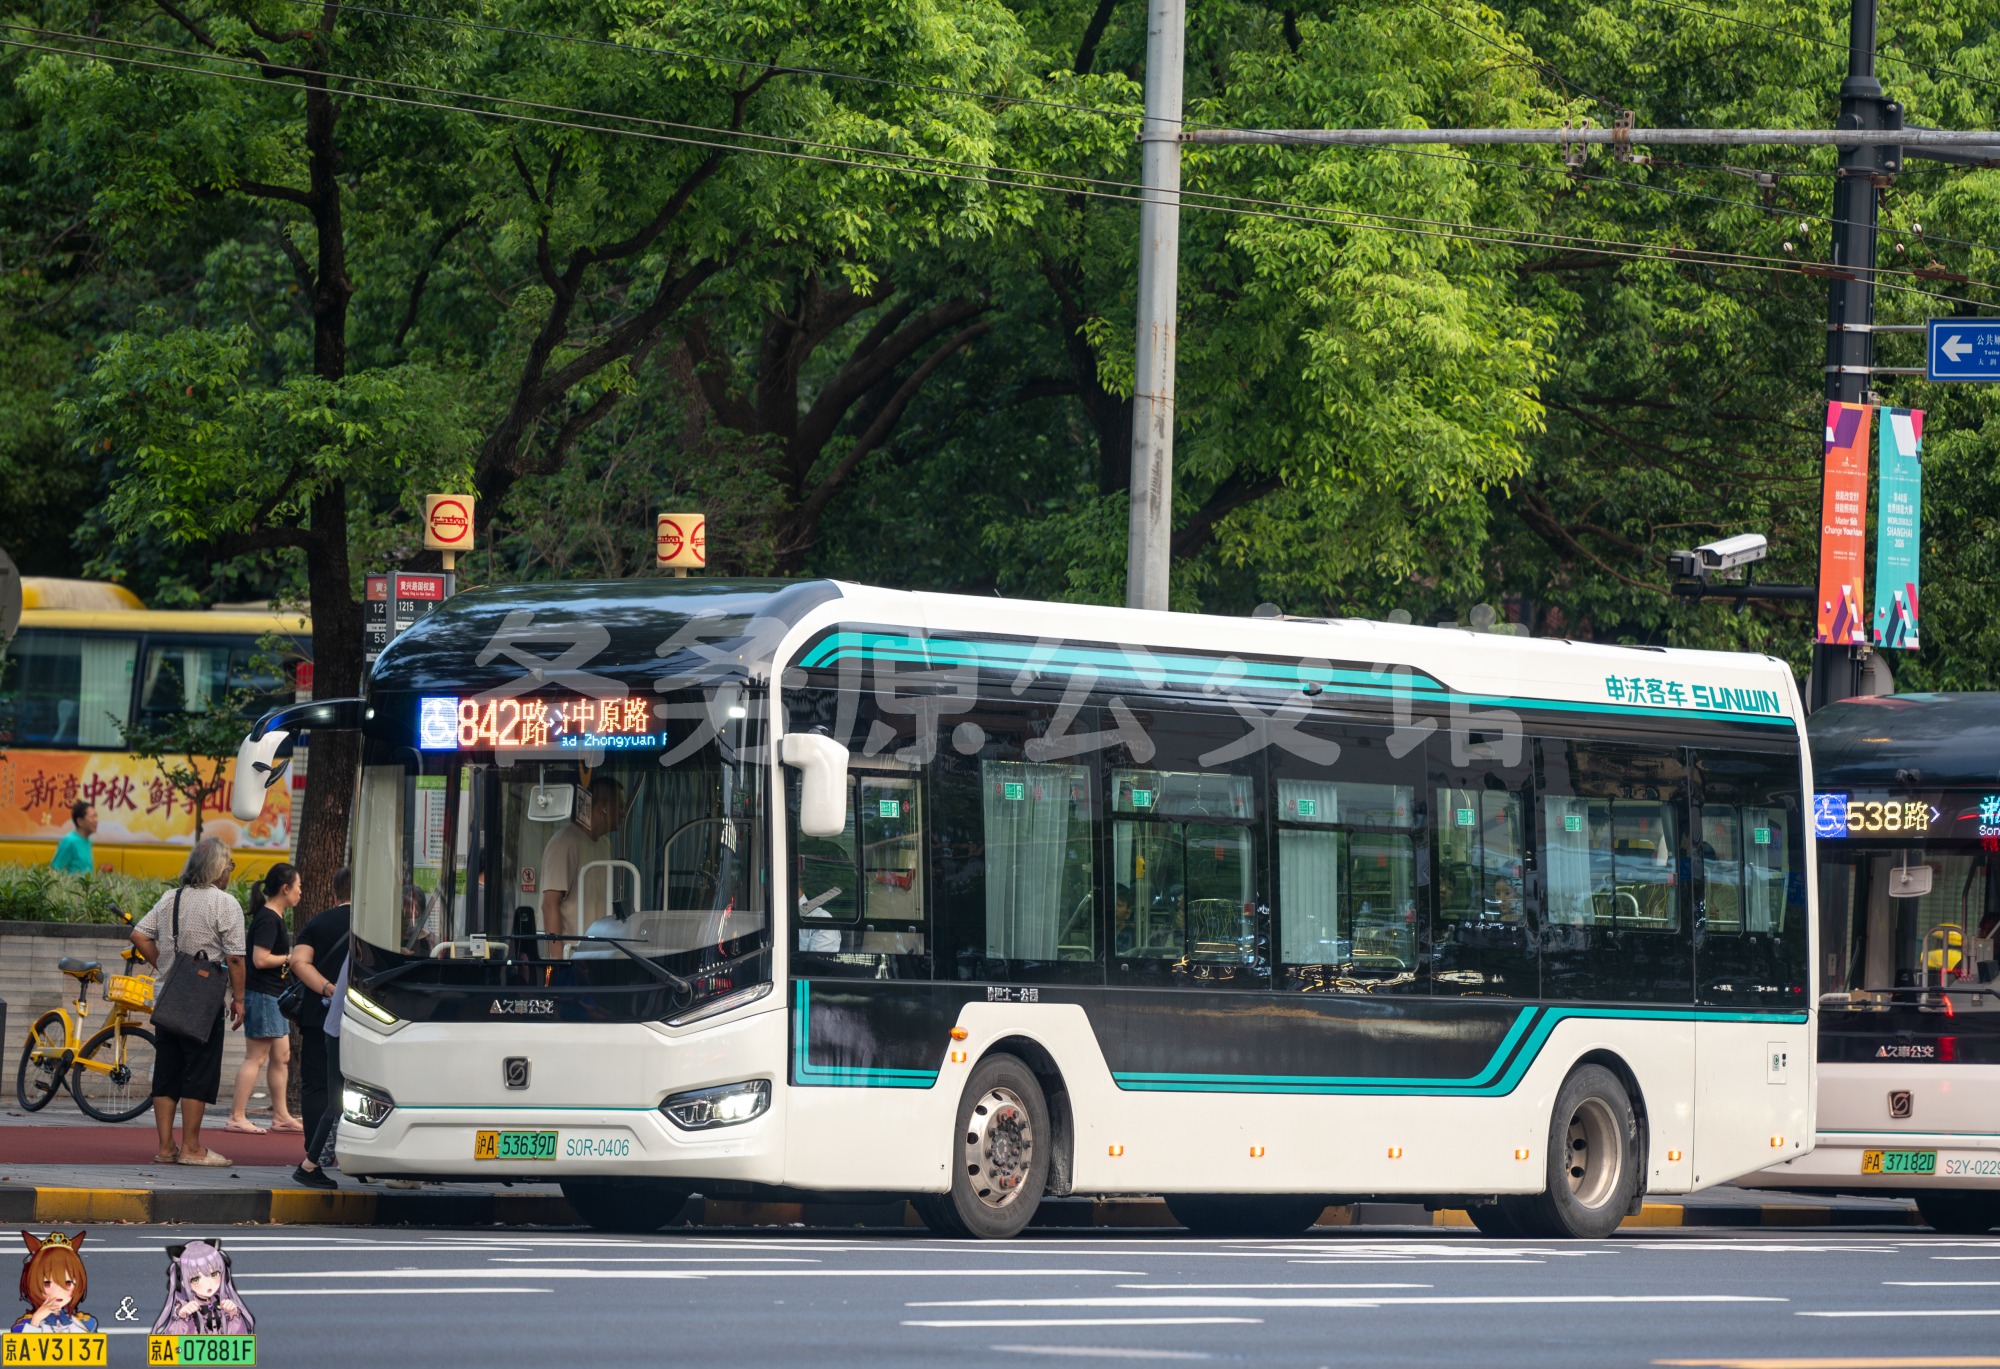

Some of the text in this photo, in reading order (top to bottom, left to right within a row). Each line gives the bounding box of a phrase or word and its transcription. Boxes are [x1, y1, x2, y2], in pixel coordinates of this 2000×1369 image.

[1824, 526, 1843, 536] Change
[1887, 527, 1913, 538] SHANGHAI
[373, 603, 386, 613] 12
[398, 601, 414, 612] 1215
[1605, 674, 1781, 713] 申沃客车 SUNWIN
[458, 698, 549, 747] 842路
[584, 734, 655, 747] Zhongyuan
[1846, 800, 1930, 832] 538路
